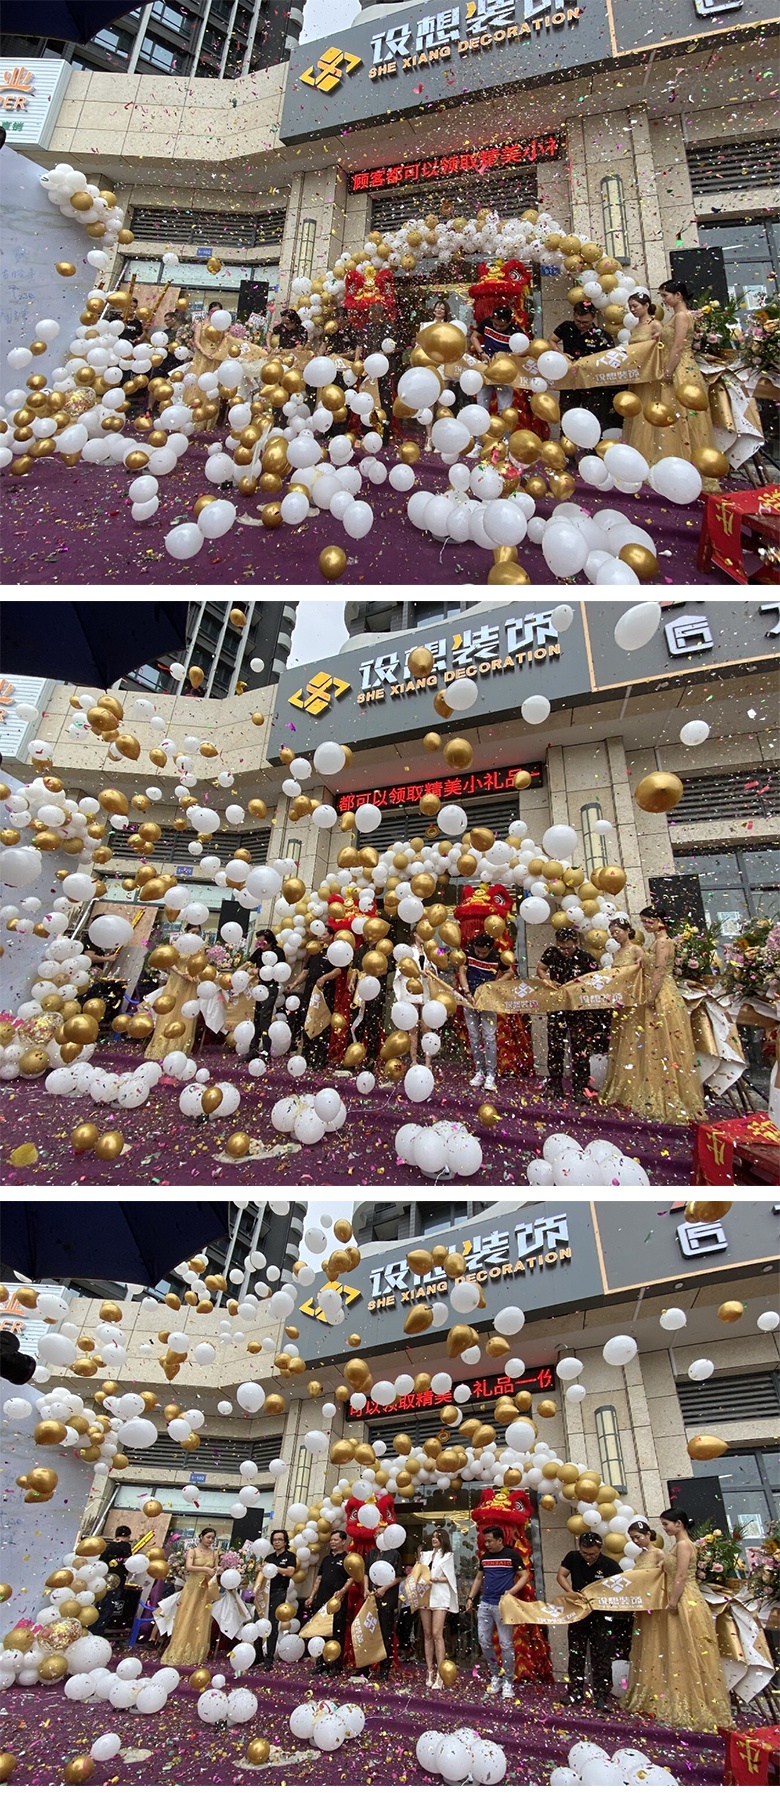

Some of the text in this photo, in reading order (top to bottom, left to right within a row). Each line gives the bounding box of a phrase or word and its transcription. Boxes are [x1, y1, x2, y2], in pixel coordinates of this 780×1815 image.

[368, 7, 580, 79] SHE XIANG DECORATION
[356, 644, 561, 704] SHE XIANG DECORATION
[367, 1247, 572, 1311] SHE XIANG DECORATION
[350, 1368, 552, 1417] 可以取精美礼品一份
